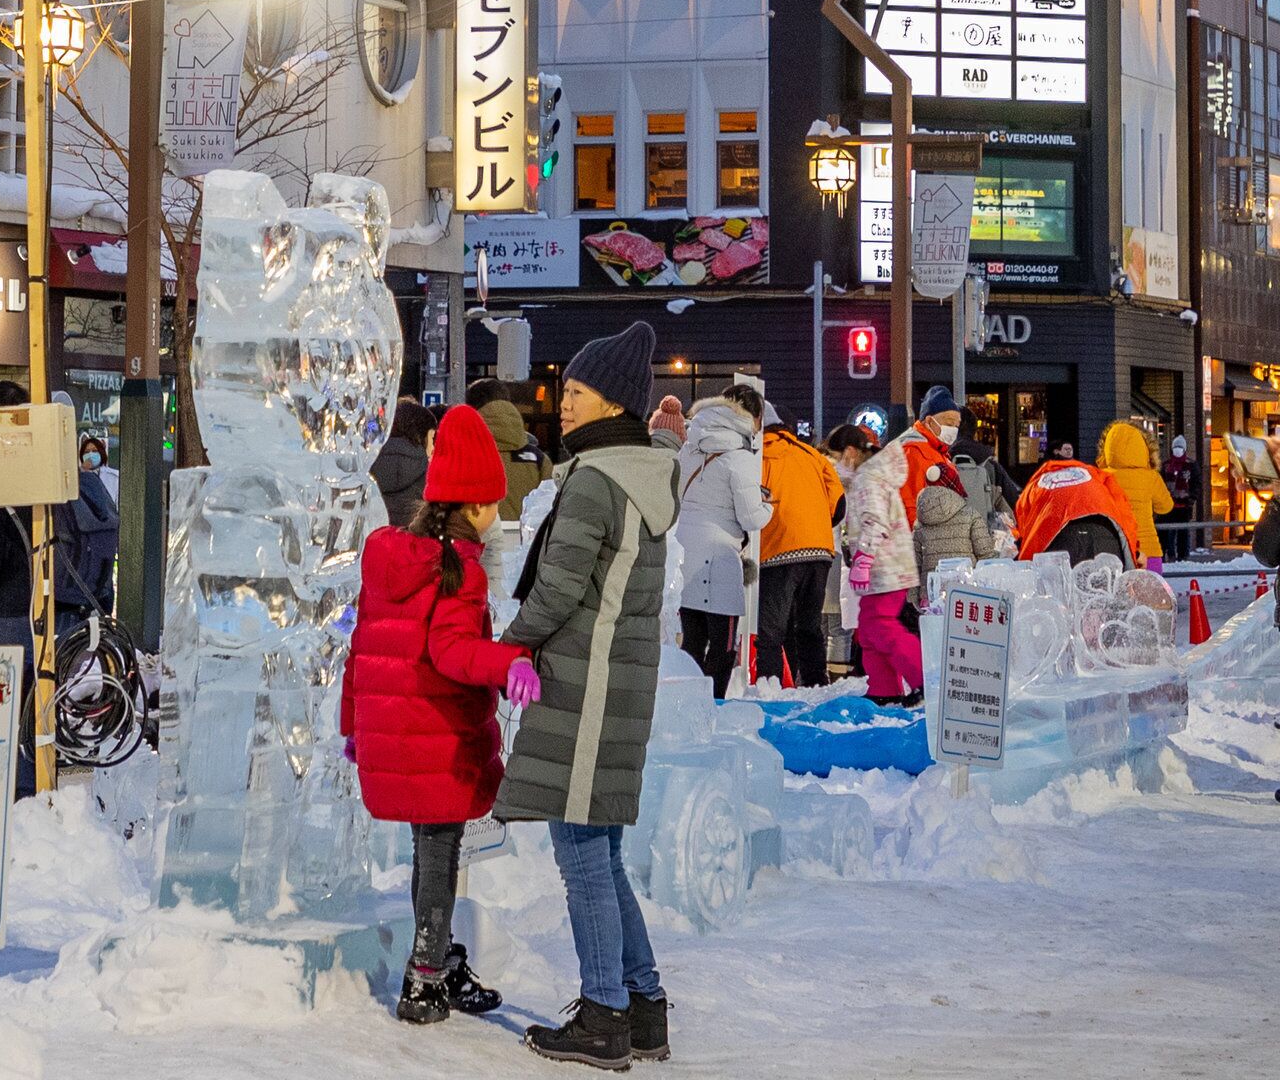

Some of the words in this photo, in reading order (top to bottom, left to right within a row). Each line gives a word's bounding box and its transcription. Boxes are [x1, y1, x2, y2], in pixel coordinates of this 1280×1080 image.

[962, 69, 988, 82] RAD
[172, 134, 196, 146] Suki
[200, 134, 226, 146] Suki
[172, 148, 224, 160] Susukino
[915, 226, 967, 243] すすきの
[914, 245, 966, 262] SUSUKINO
[955, 599, 994, 625] 自動車
